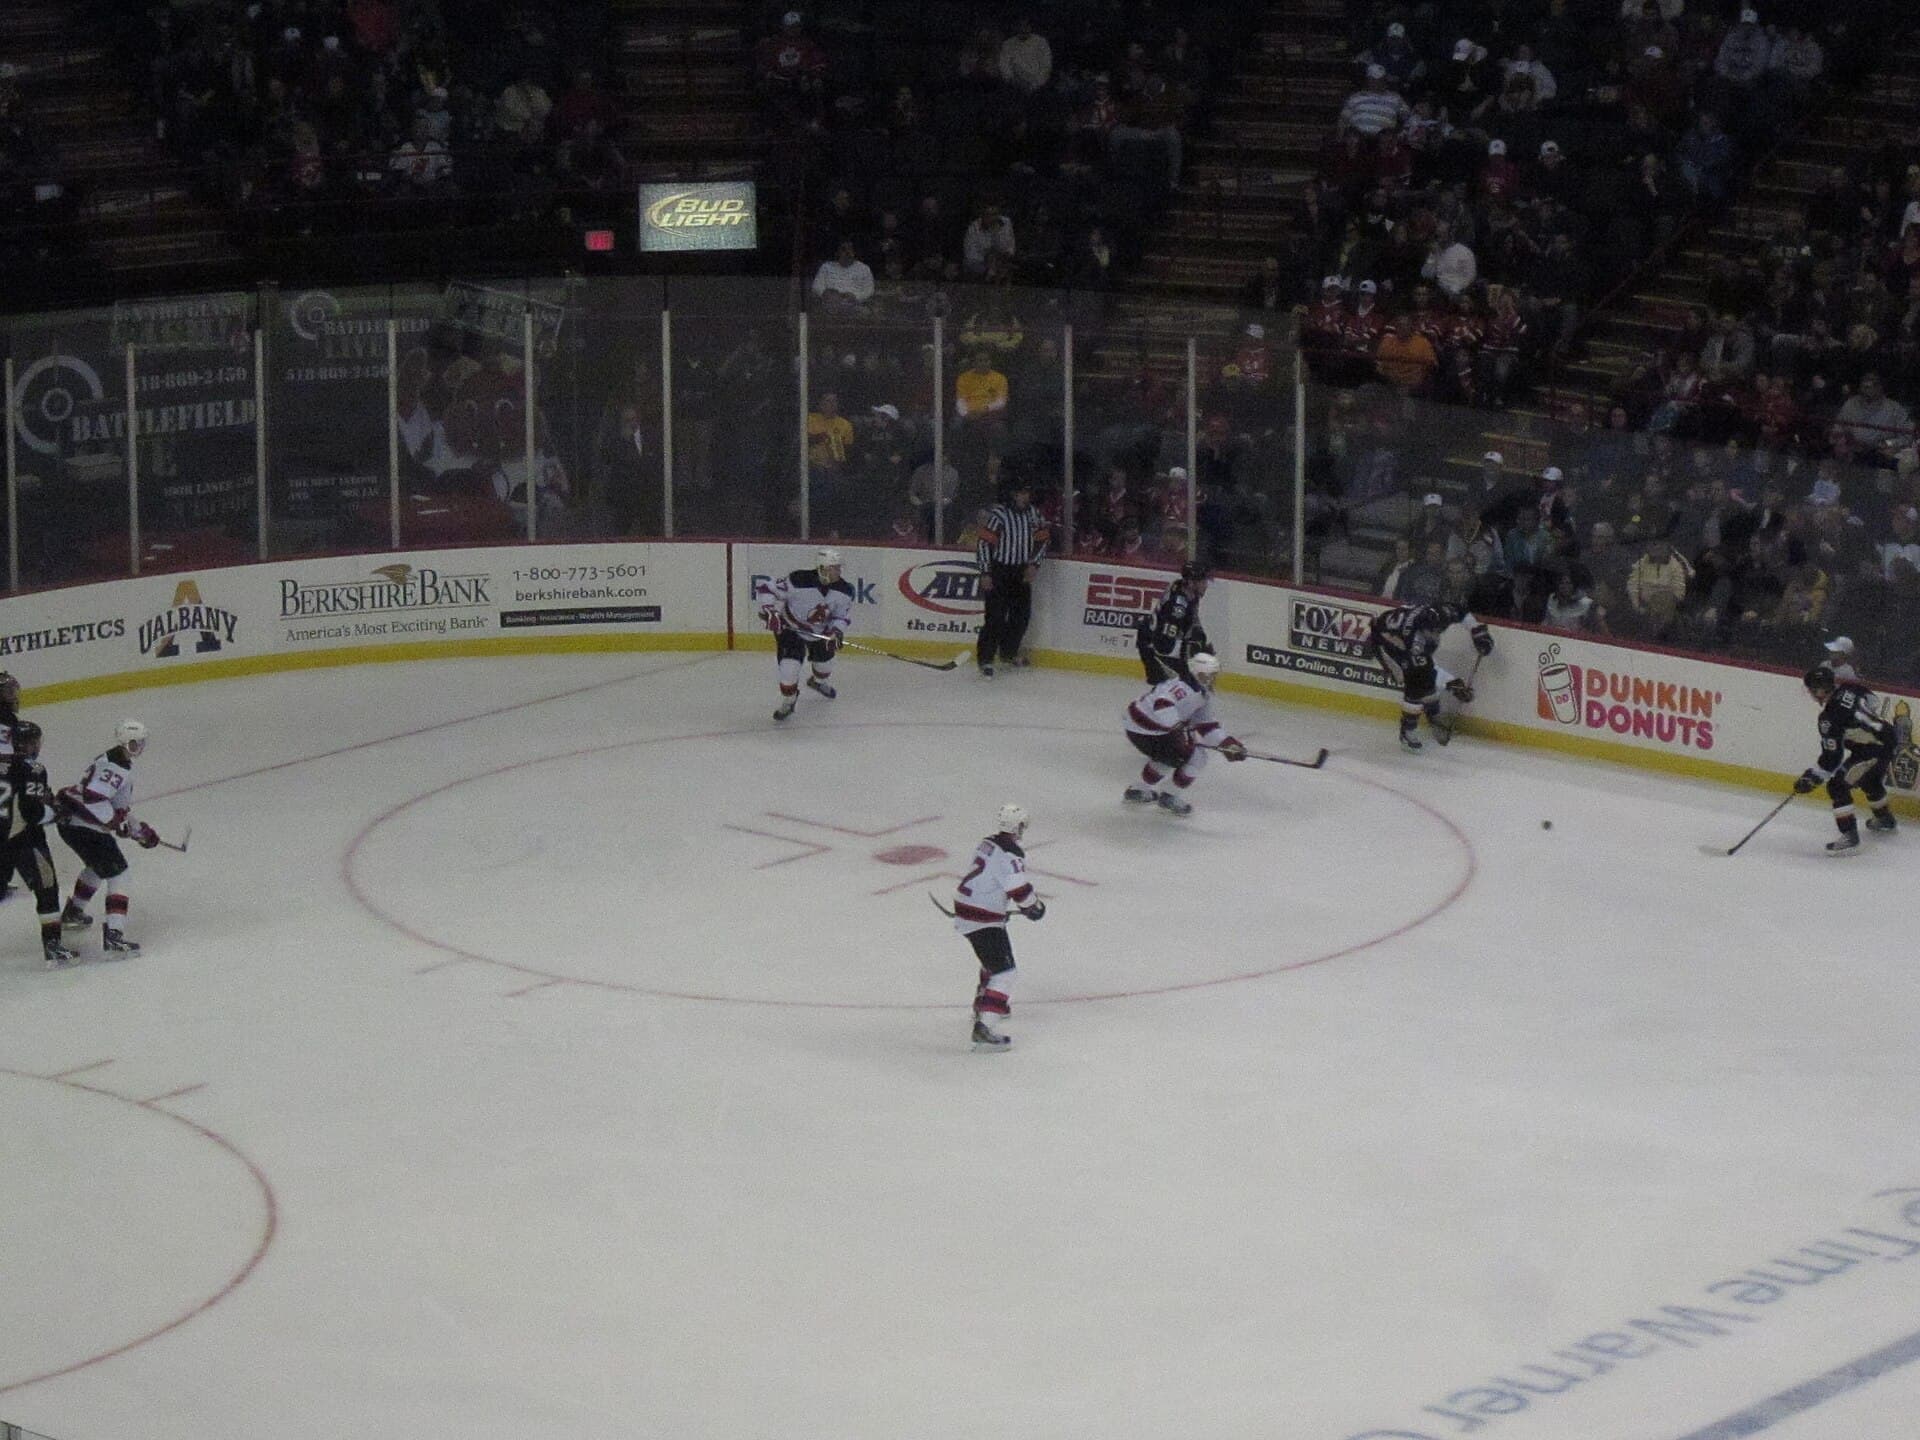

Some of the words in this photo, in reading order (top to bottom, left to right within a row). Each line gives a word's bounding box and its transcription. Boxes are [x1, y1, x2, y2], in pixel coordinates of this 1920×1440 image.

[674, 200, 744, 213] BUD
[659, 213, 750, 227] LIGHT
[512, 564, 647, 581] 1-800-773-5601
[515, 587, 648, 602] berkshirebank.com
[1086, 573, 1171, 612] ESP
[138, 606, 239, 655] UALBANY
[286, 625, 351, 642] America's
[354, 623, 388, 636] Most
[392, 617, 447, 634] Exciting
[450, 616, 486, 630] Bank
[1084, 610, 1134, 628] RADIO
[0, 618, 125, 657] ATHLETICS
[1300, 637, 1365, 658] NEWS
[1251, 650, 1271, 663] On
[1273, 653, 1293, 667] TV.
[1295, 656, 1340, 676] Online.
[1342, 666, 1362, 680] On
[1363, 669, 1385, 685] the
[1585, 668, 1723, 719] DUNKIN'
[1585, 699, 1714, 750] DONUTS
[26, 781, 45, 796] 22
[99, 768, 124, 791] 33
[1706, 1228, 1920, 1303] Time
[1420, 1305, 1763, 1433] Warner
